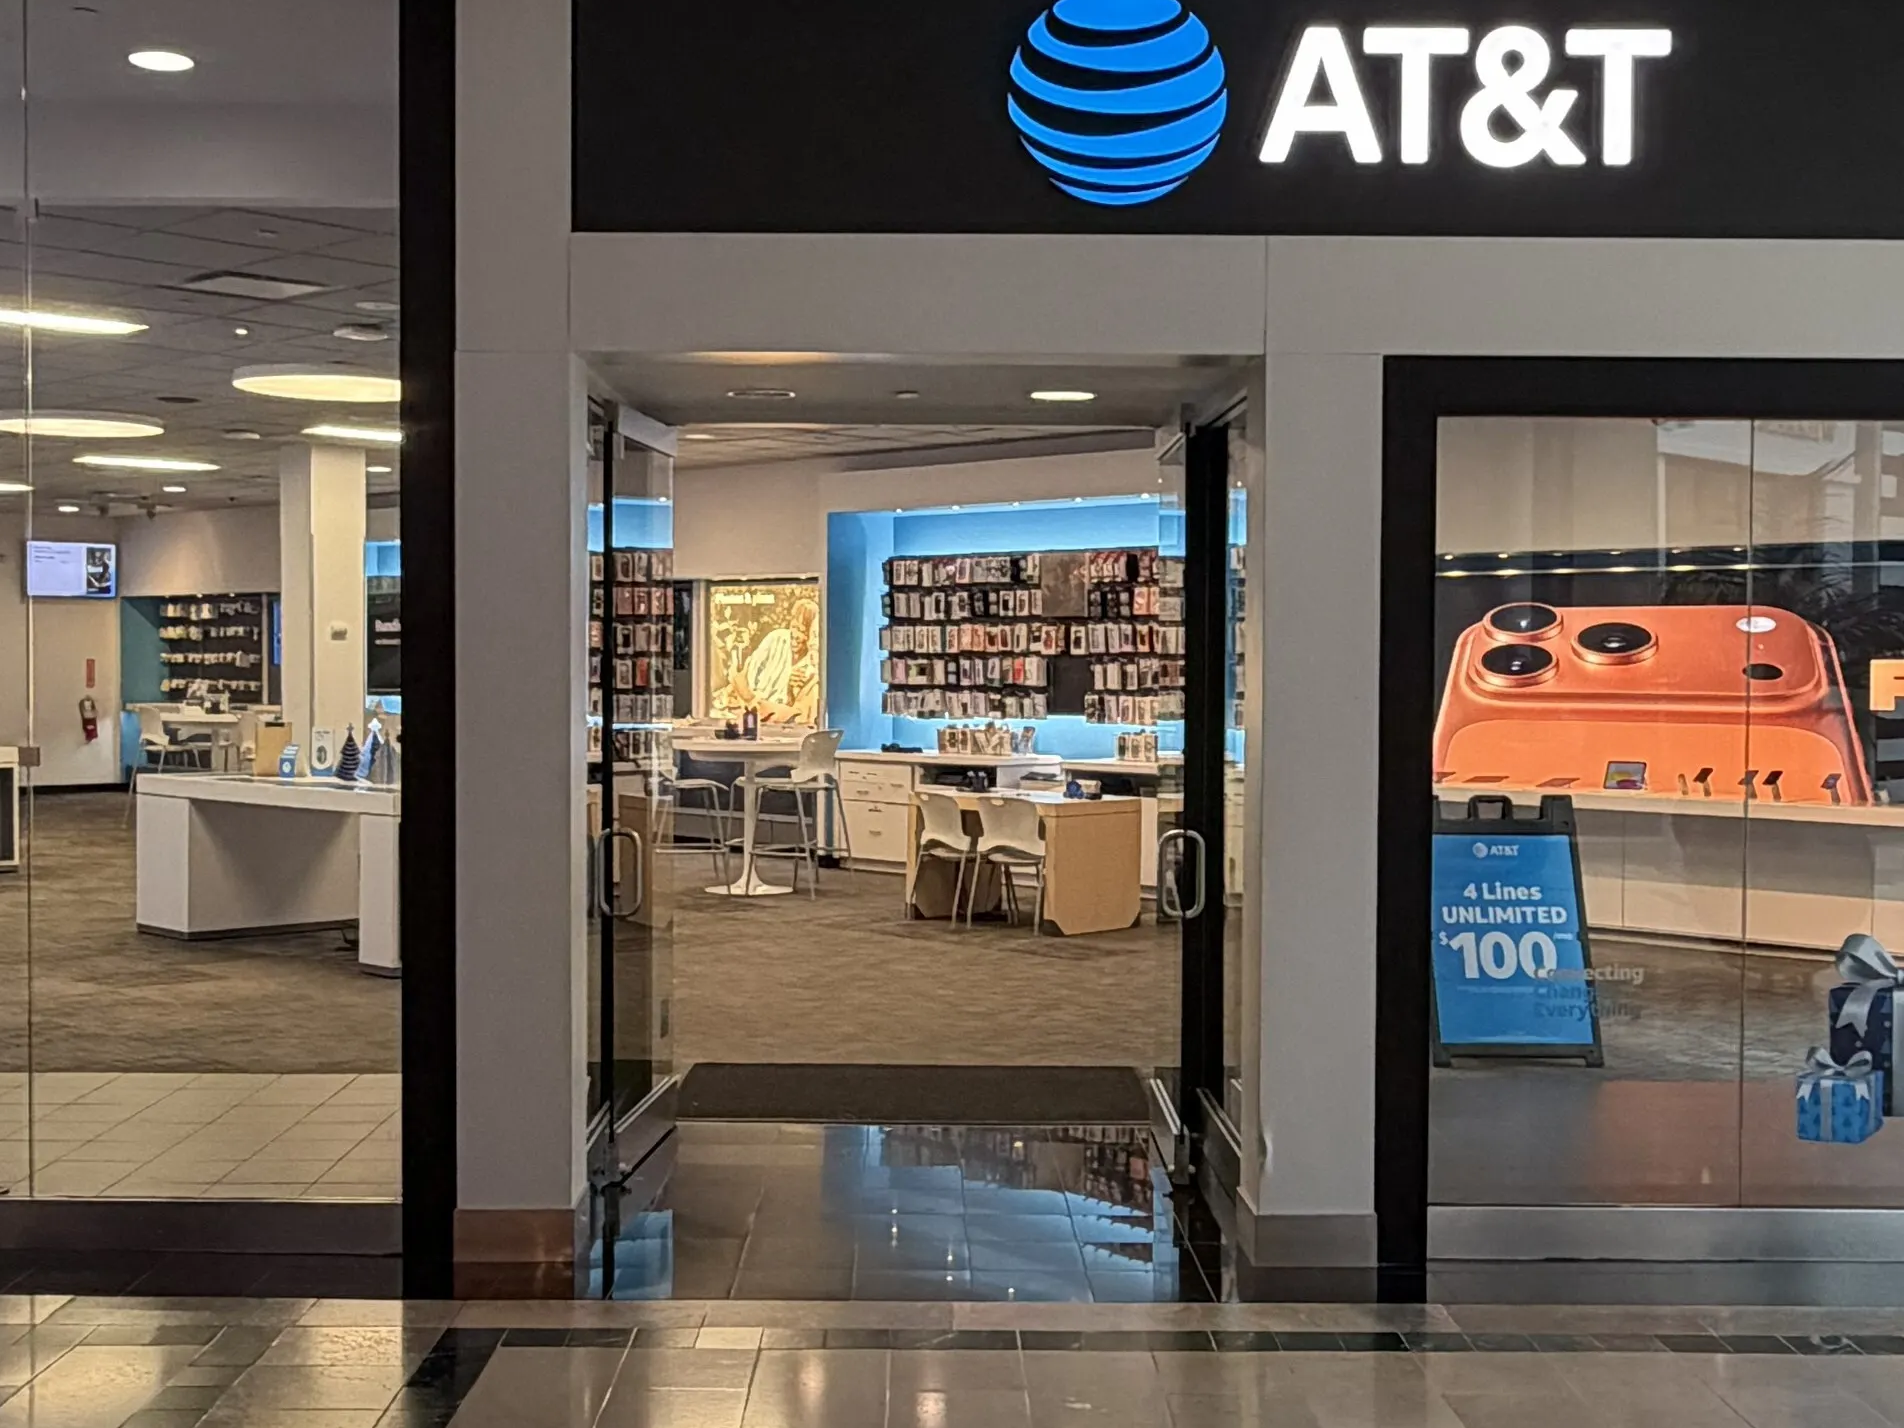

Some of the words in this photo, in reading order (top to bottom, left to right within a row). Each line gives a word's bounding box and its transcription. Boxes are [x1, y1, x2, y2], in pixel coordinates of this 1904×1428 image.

[1257, 25, 1673, 170] AT&T
[1489, 844, 1520, 857] AT&T
[1463, 883, 1478, 900] 4
[1482, 881, 1542, 900] Lines
[1442, 906, 1567, 925] UNLIMITED
[1438, 931, 1557, 980] $100
